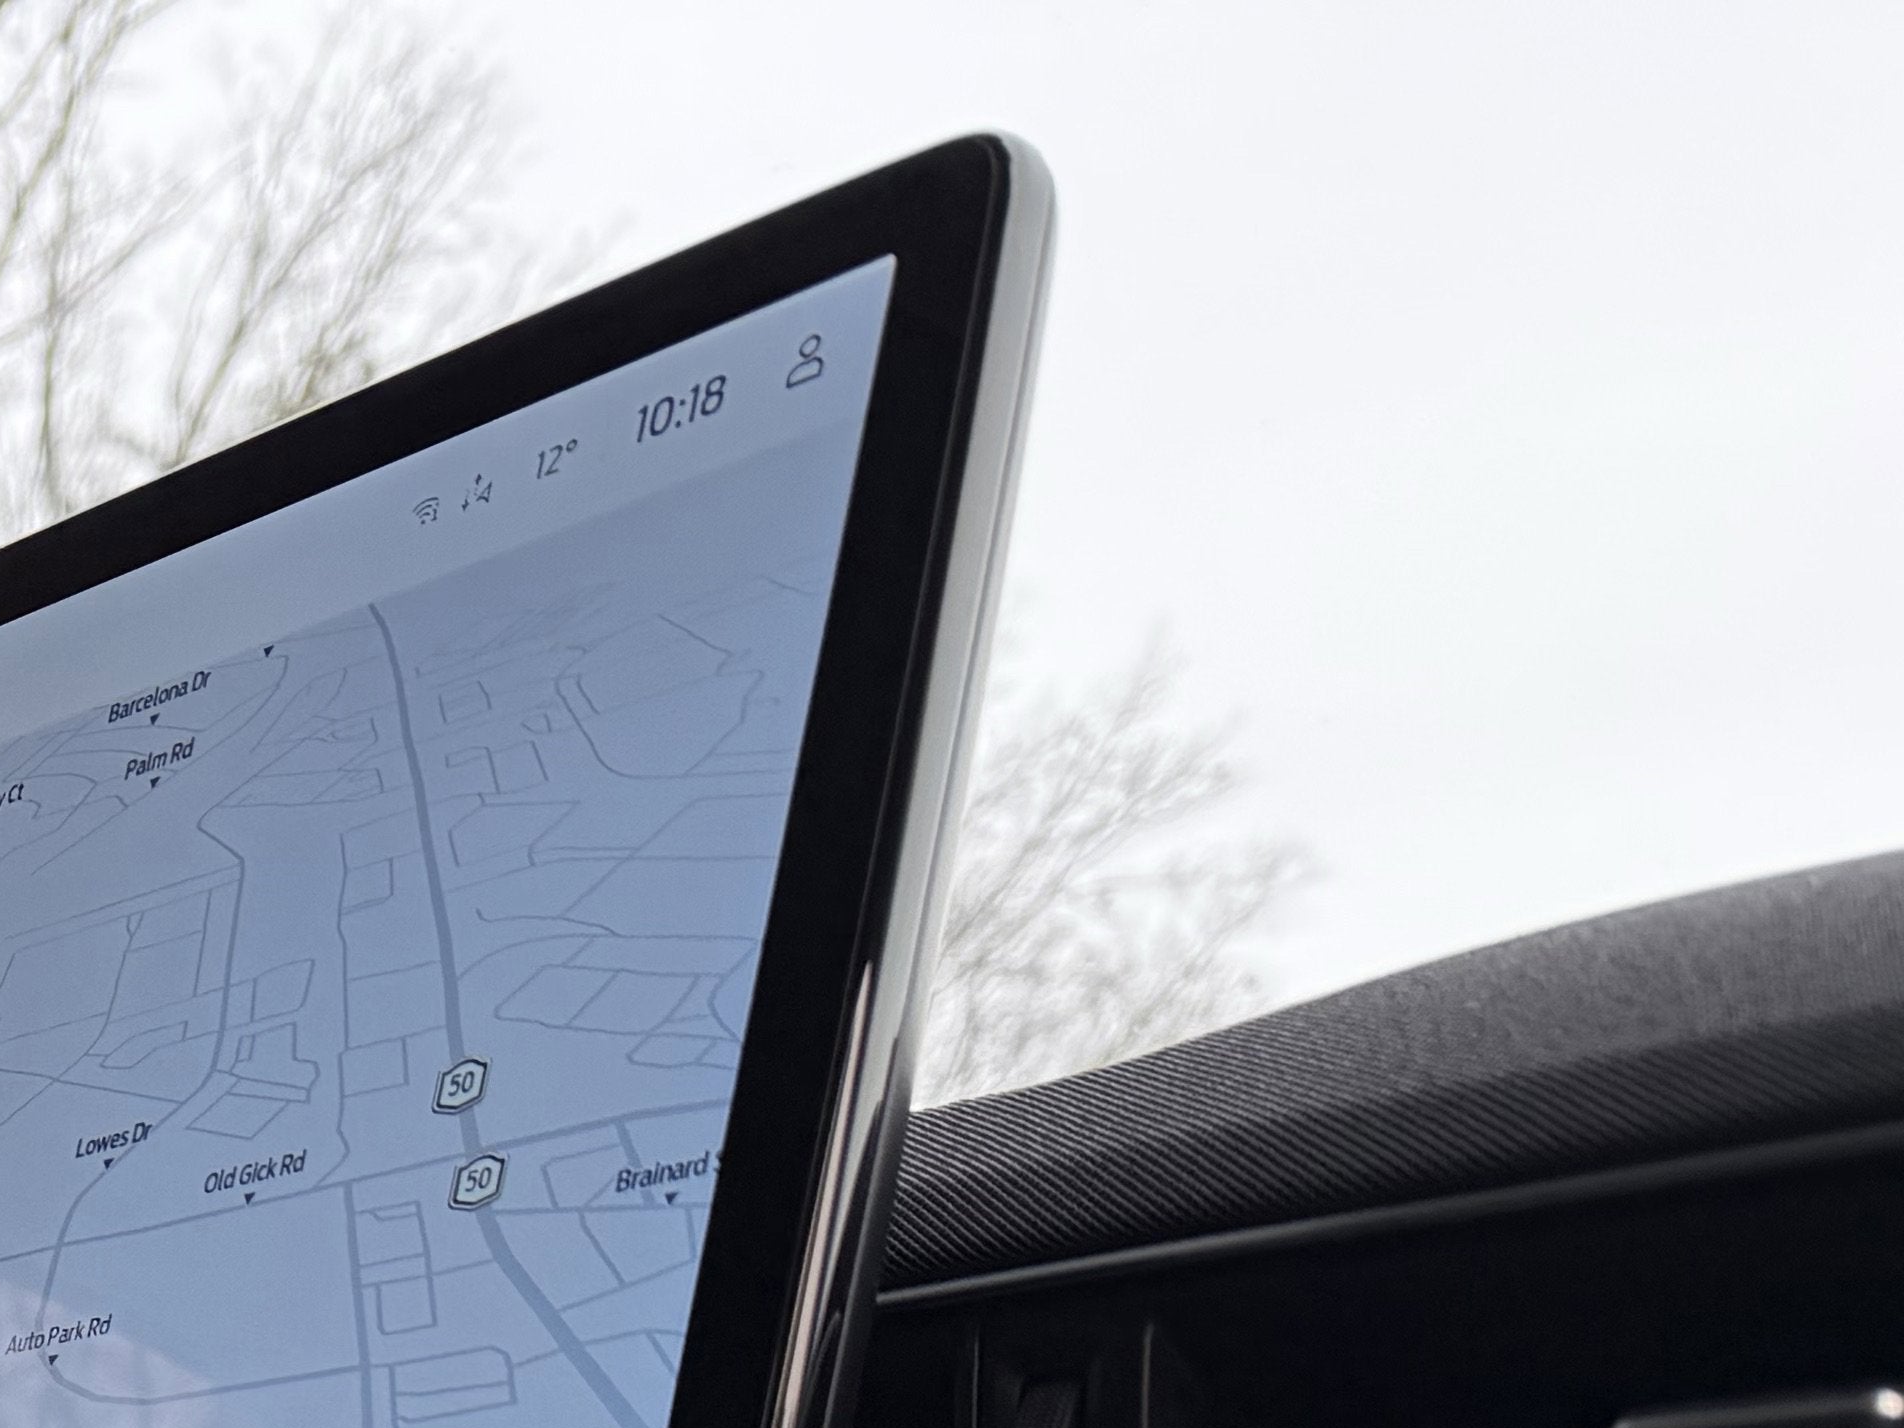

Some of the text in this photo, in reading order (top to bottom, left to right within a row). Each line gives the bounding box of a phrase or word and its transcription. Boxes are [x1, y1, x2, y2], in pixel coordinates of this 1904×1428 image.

[637, 375, 726, 443] 10:18
[537, 438, 578, 479] 12°
[108, 671, 211, 723] Barcelona Dr
[124, 736, 195, 780] Palm Rd
[8, 782, 25, 803] Ct
[448, 1070, 474, 1097] 50
[75, 1122, 153, 1158] Lowes Dr
[204, 1149, 307, 1193] Old Gick Rd
[465, 1166, 492, 1192] 50
[616, 1151, 709, 1192] Brainard
[5, 1313, 112, 1355] Auto Park Rd
